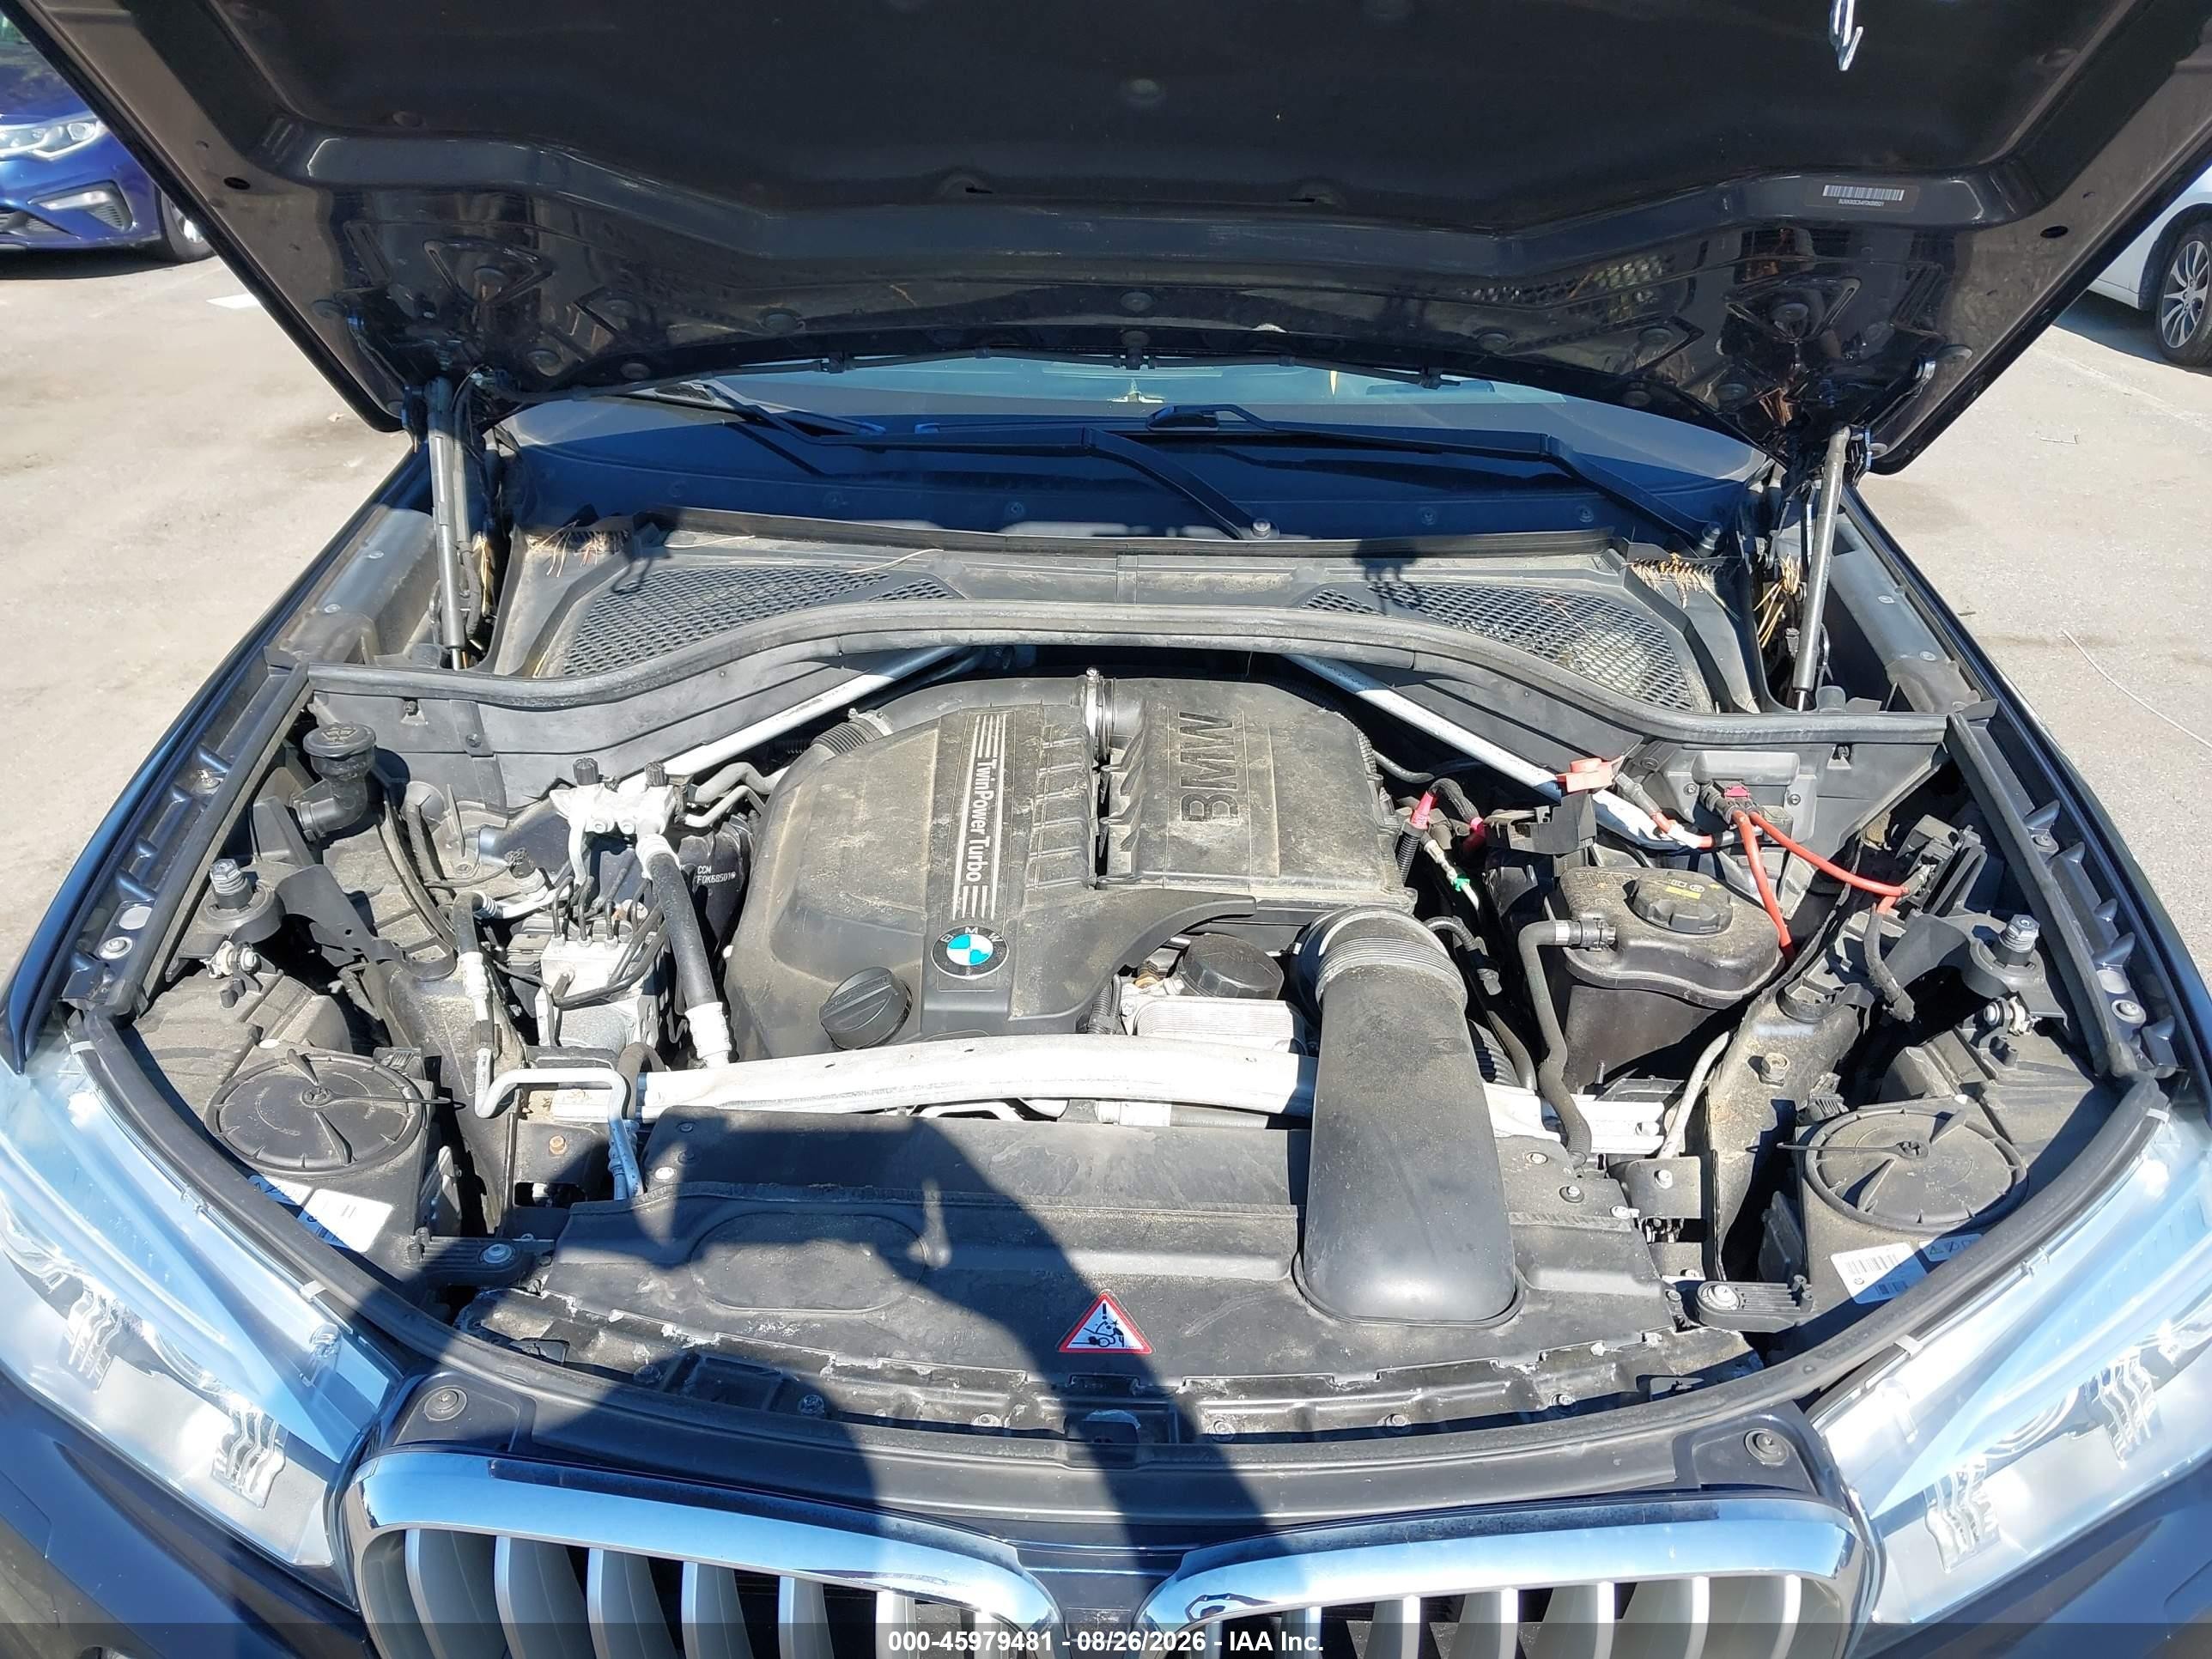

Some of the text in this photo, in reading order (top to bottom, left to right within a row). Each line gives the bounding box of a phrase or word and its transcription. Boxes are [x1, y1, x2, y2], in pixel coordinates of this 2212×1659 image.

[965, 758, 998, 883] TwinPower Turbo
[1179, 711, 1240, 823] BMW
[939, 927, 1004, 944] BMW
